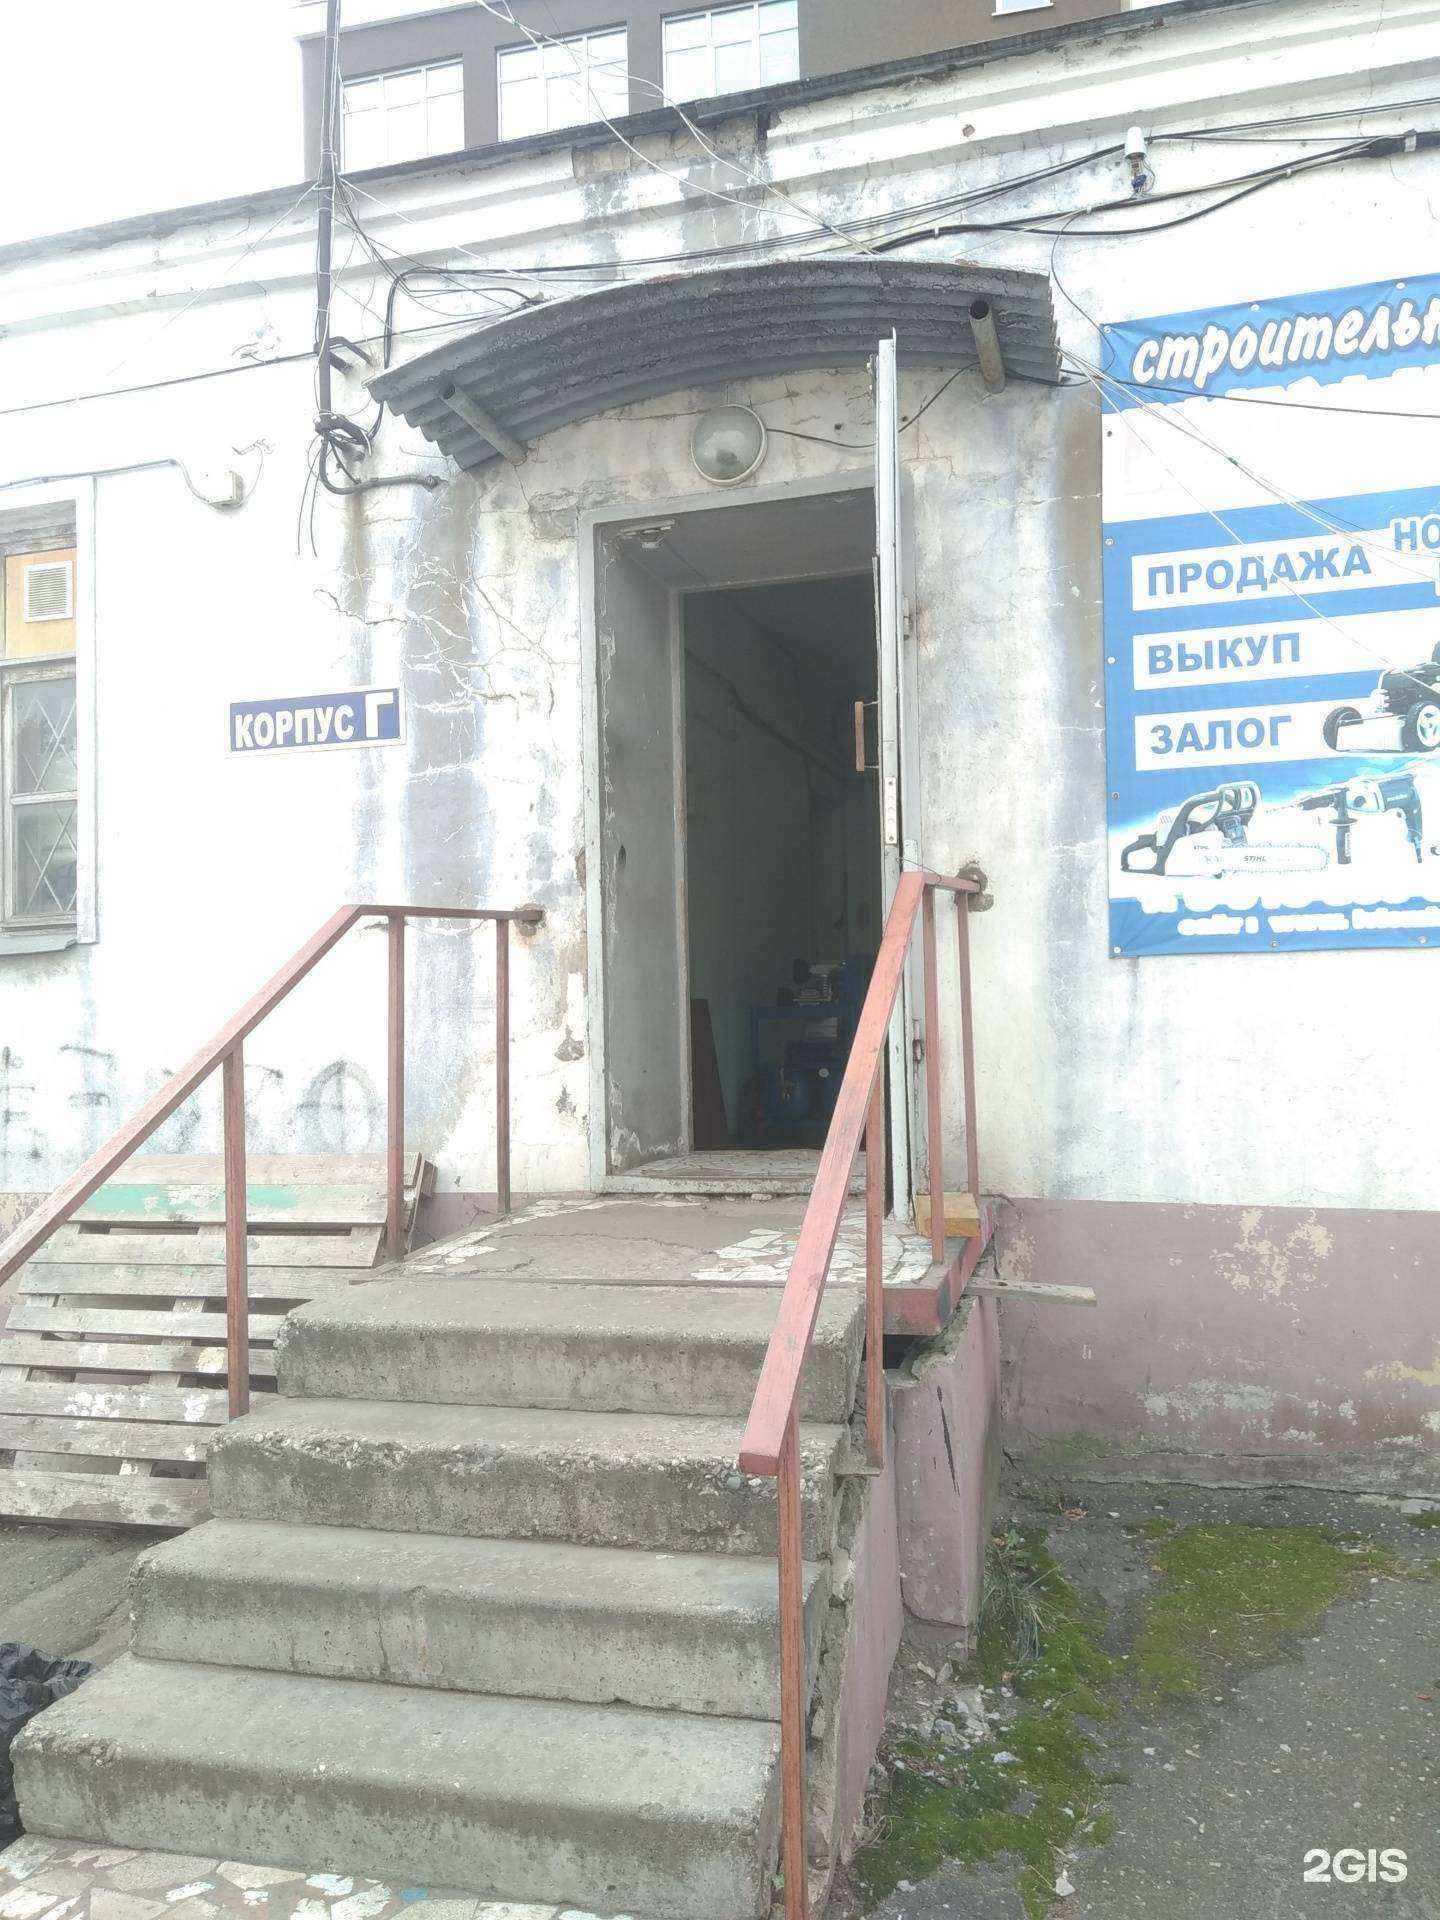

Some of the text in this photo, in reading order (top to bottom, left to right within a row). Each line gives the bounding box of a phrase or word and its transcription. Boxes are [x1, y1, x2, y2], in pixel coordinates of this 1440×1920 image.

[1148, 545, 1372, 596] ПРОДАЖА
[1148, 632, 1301, 675] ВЫКУП
[234, 691, 394, 749] КОРПУС Г
[1149, 715, 1292, 755] ЗАЛОГ
